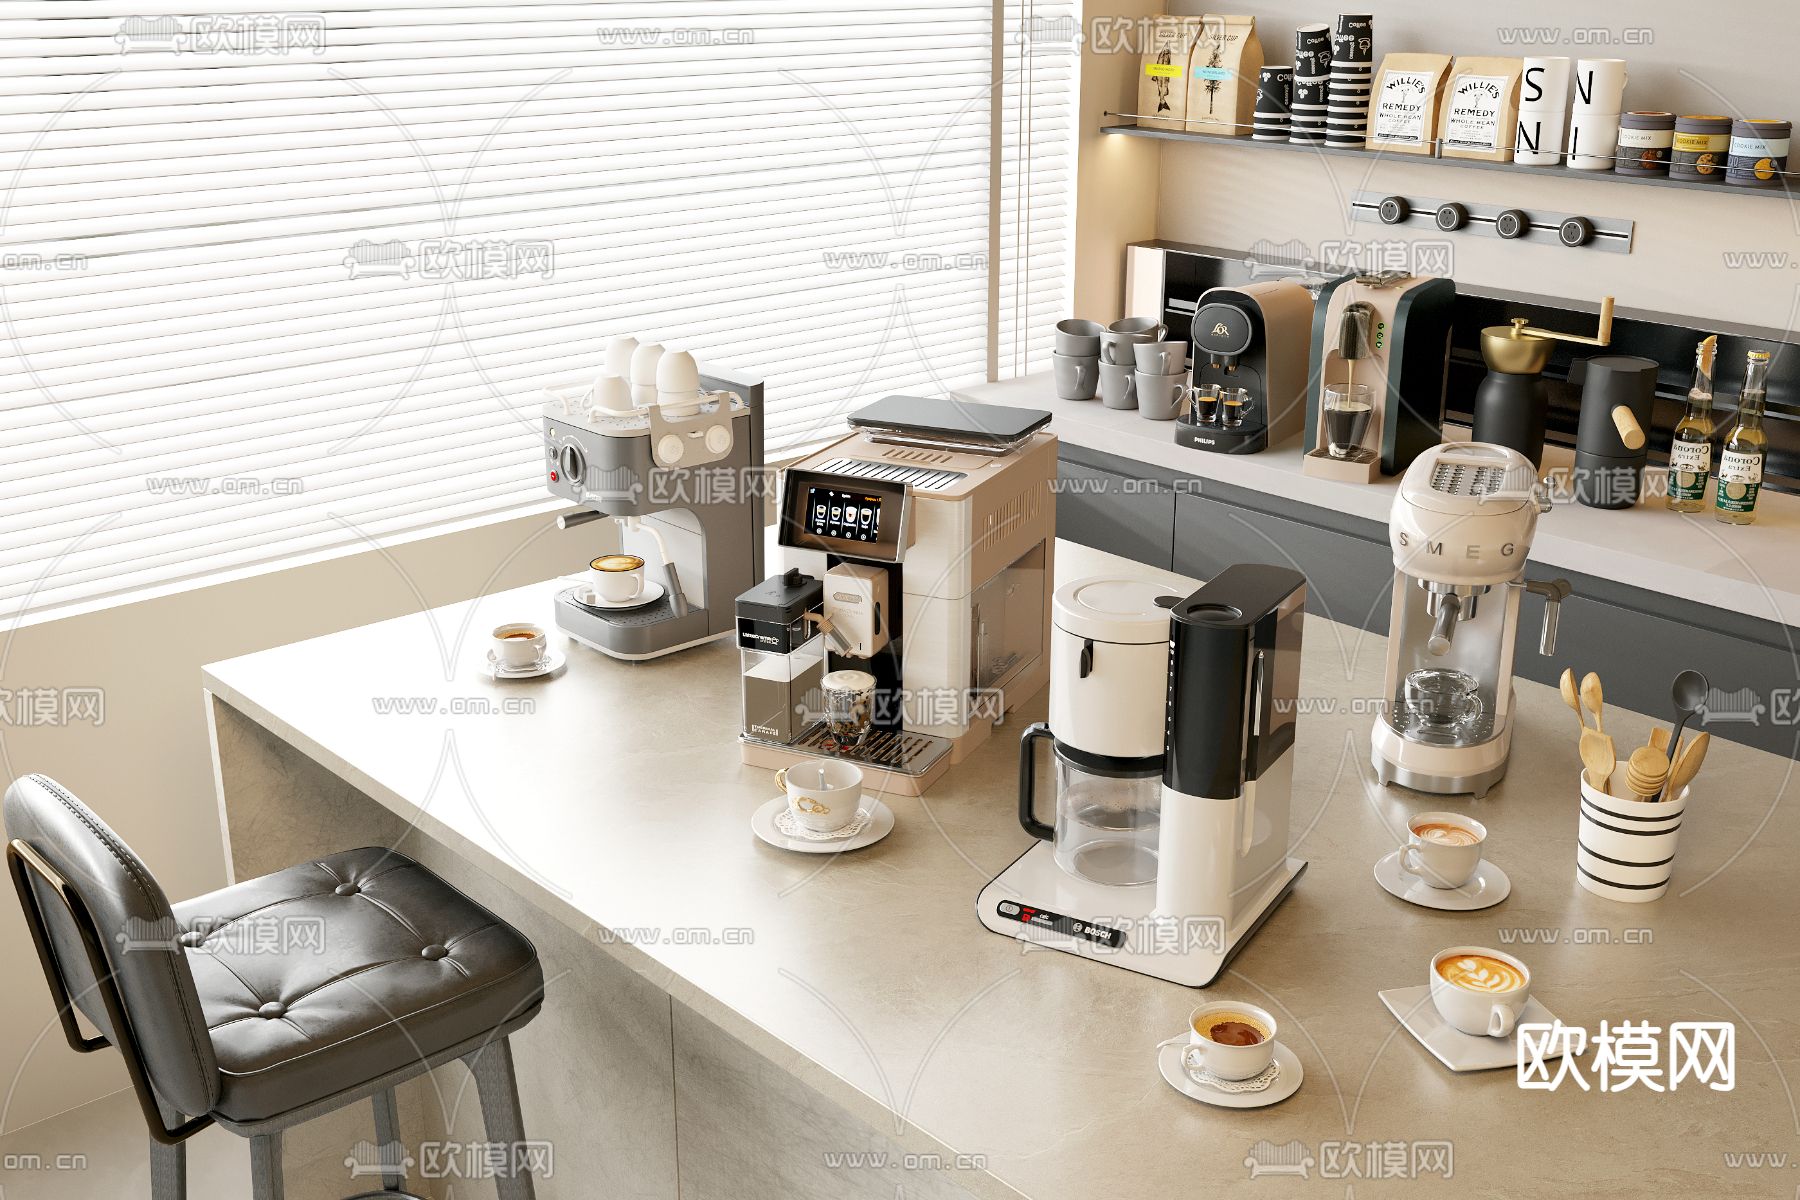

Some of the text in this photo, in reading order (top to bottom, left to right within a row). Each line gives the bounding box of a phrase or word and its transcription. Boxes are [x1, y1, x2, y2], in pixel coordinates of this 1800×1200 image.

[1386, 76, 1426, 94] WILLIE'S
[1457, 81, 1500, 99] WILLIE'S
[1525, 67, 1545, 102] S
[1382, 102, 1421, 112] REMEDY
[1454, 108, 1496, 118] REMEDY
[1451, 117, 1474, 125] WHOLE
[1516, 121, 1541, 155] N
[1734, 142, 1753, 150] COOKIE
[1194, 436, 1215, 446] PHILIPS
[1399, 532, 1515, 560] SMEG
[1084, 926, 1112, 940] BOSCH
